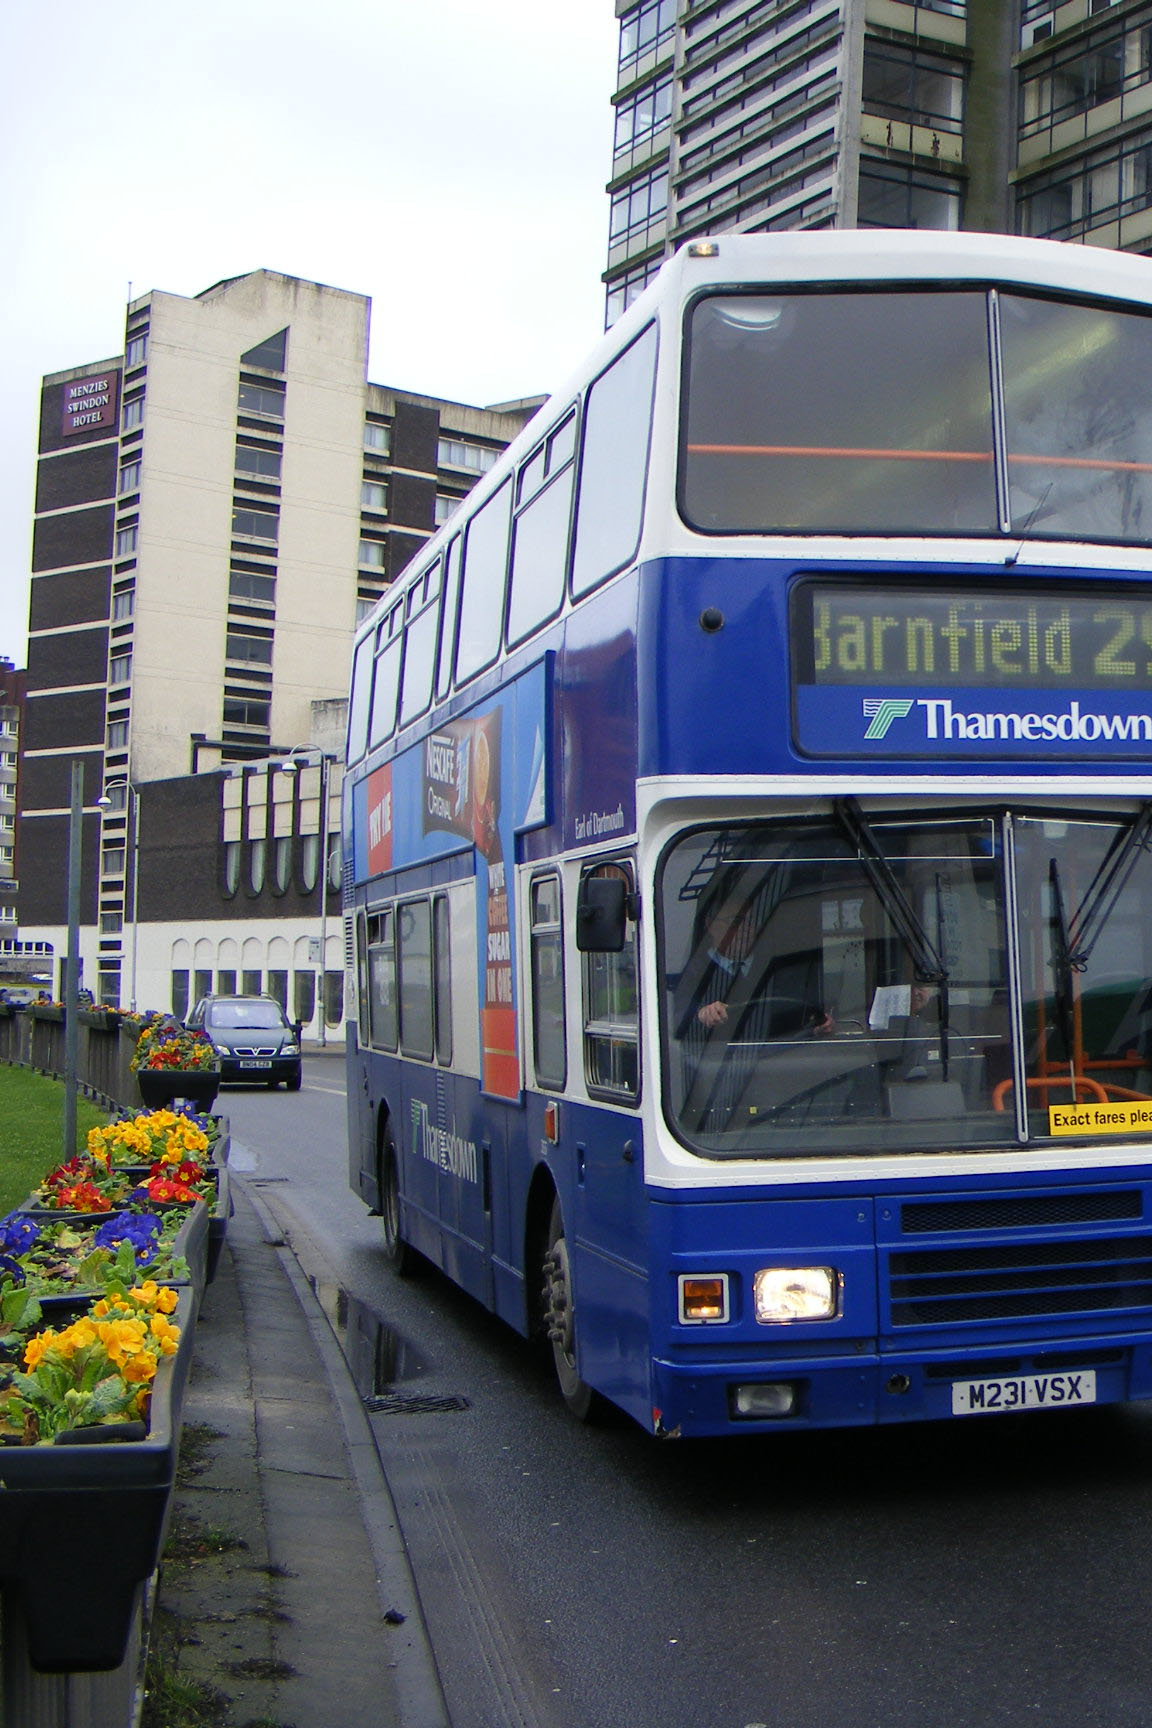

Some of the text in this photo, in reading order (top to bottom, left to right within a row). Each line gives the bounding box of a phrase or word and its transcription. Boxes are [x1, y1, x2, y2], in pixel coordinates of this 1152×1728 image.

[70, 379, 109, 399] MENZIES
[68, 394, 110, 414] SWINDON
[73, 411, 103, 428] HOTEL
[575, 803, 624, 839] Earl of Dartmouth
[488, 932, 511, 961] SUGAR
[497, 967, 513, 1002] ONE
[1053, 1112, 1090, 1127] Exact
[1094, 1111, 1126, 1125] fares
[969, 1375, 1082, 1409] M231 VSX
